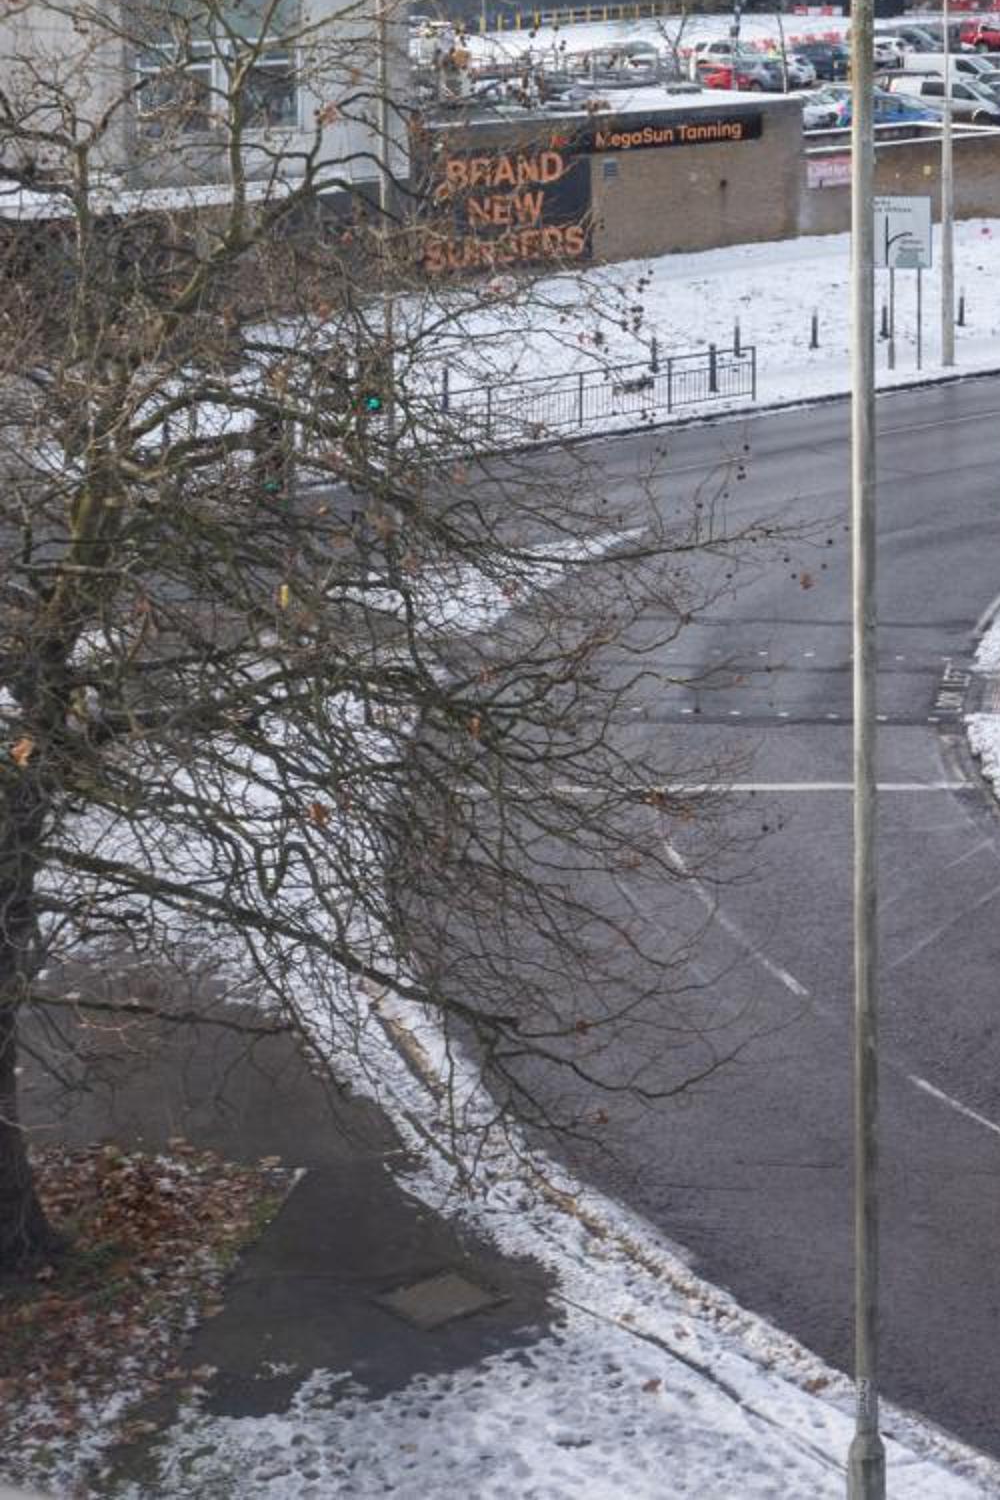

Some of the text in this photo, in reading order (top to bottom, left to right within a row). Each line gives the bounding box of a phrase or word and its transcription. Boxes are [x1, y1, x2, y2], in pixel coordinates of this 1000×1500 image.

[595, 120, 742, 148] MegaSun Tanning
[447, 151, 564, 188] BRAND
[466, 190, 544, 228] NEW
